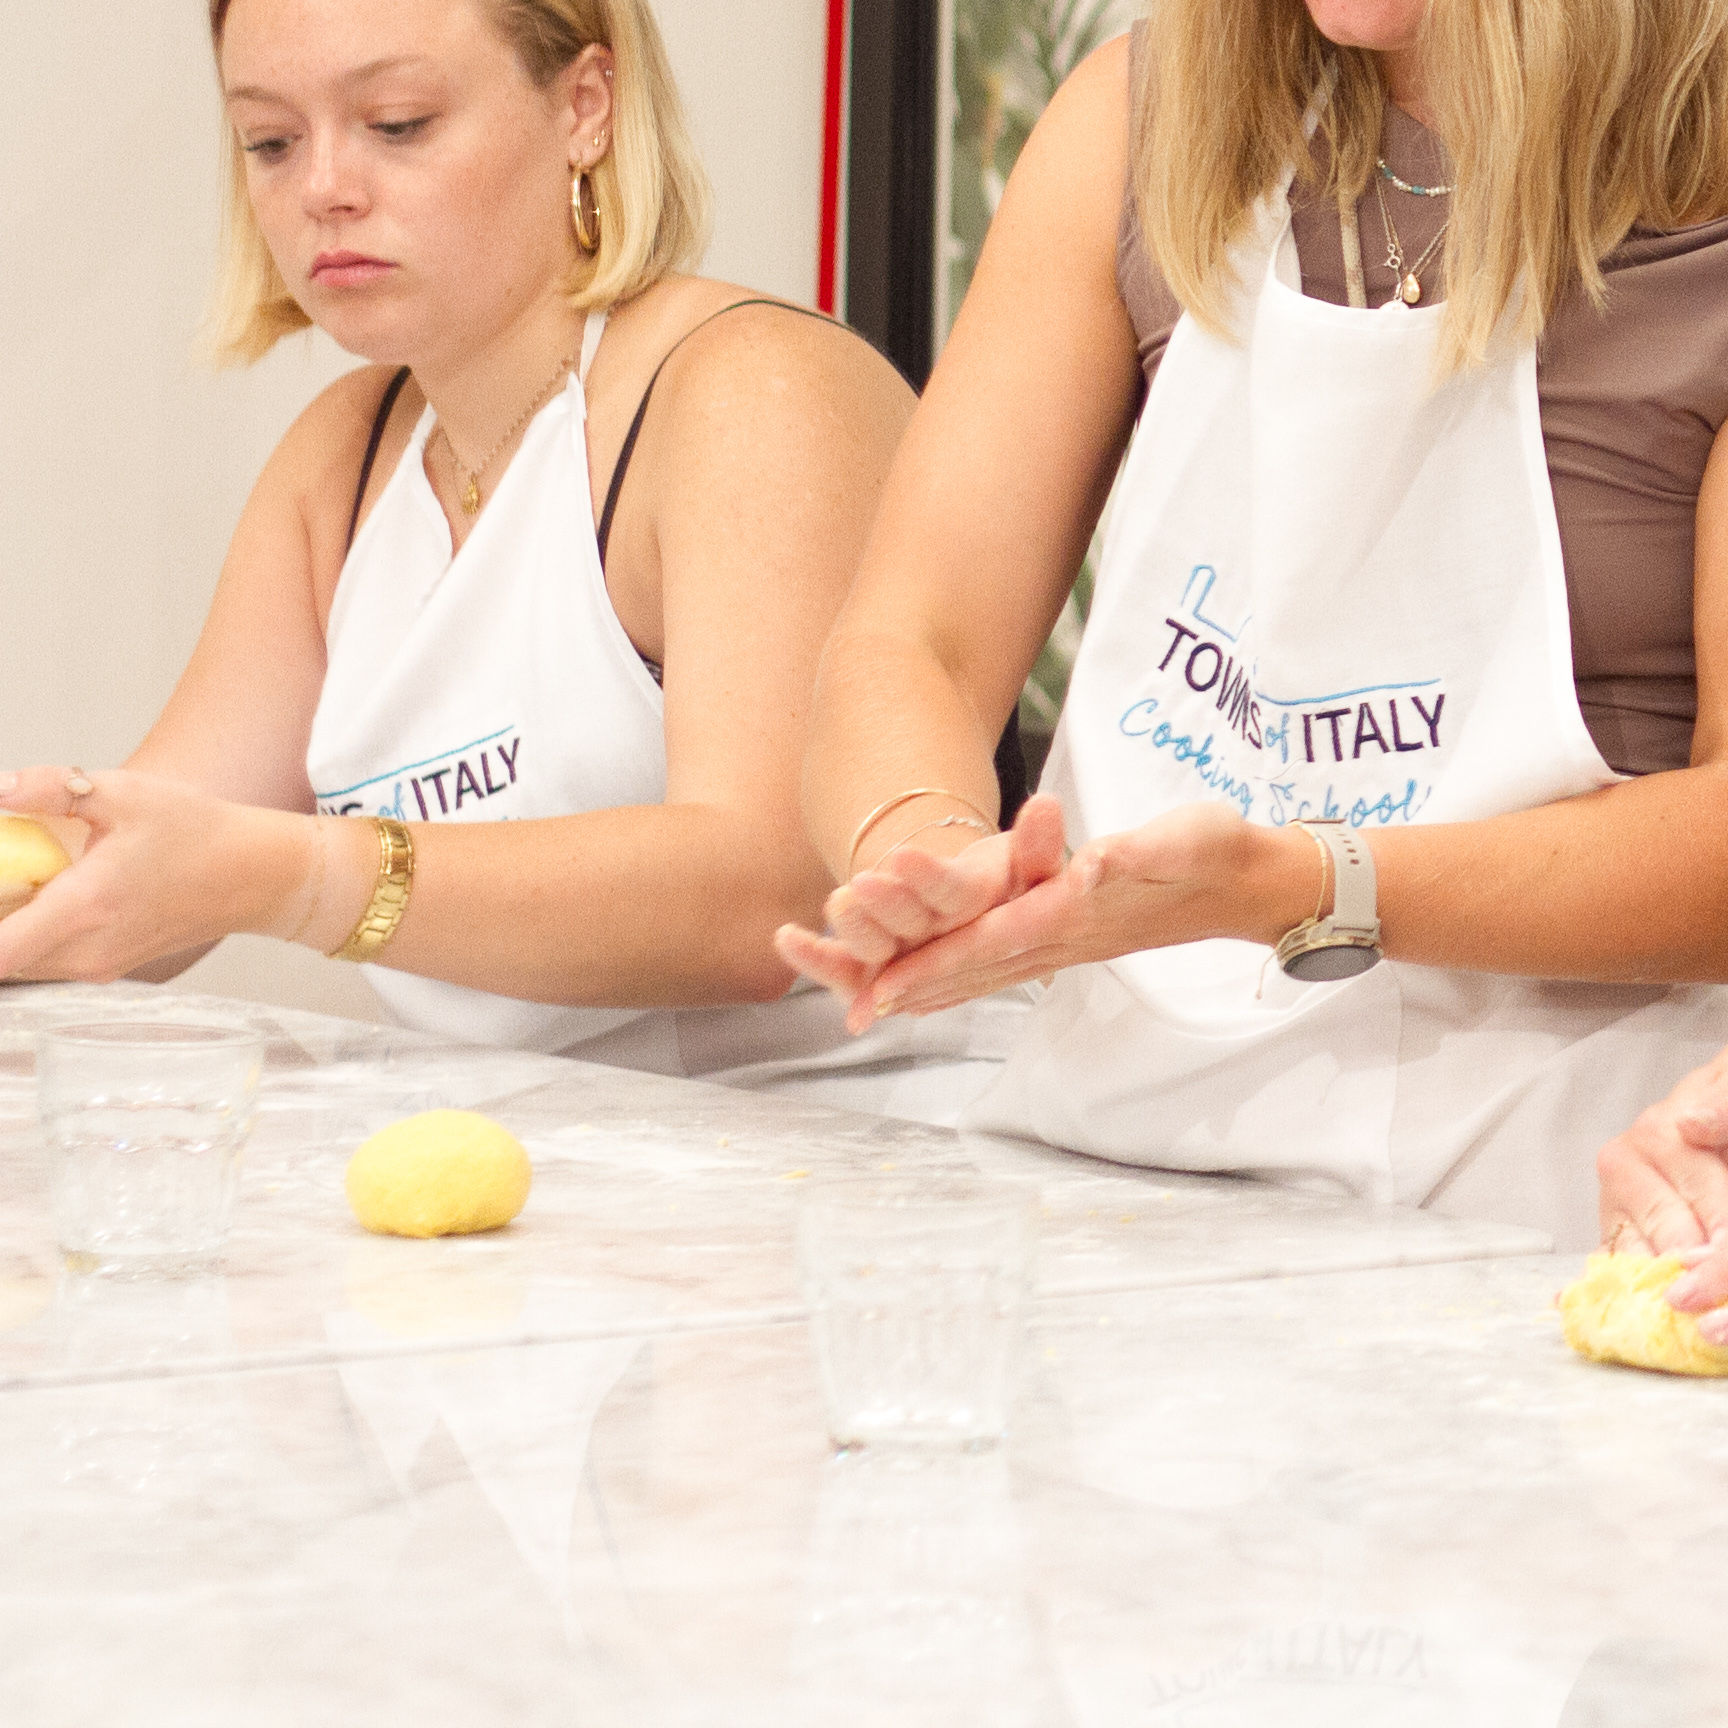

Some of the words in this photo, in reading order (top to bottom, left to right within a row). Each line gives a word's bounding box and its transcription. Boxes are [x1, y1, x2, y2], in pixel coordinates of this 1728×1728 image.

[1157, 617, 1263, 750] TOWNS
[1264, 712, 1290, 764] of
[1301, 693, 1446, 763] ITALY
[410, 736, 520, 821] ITALY
